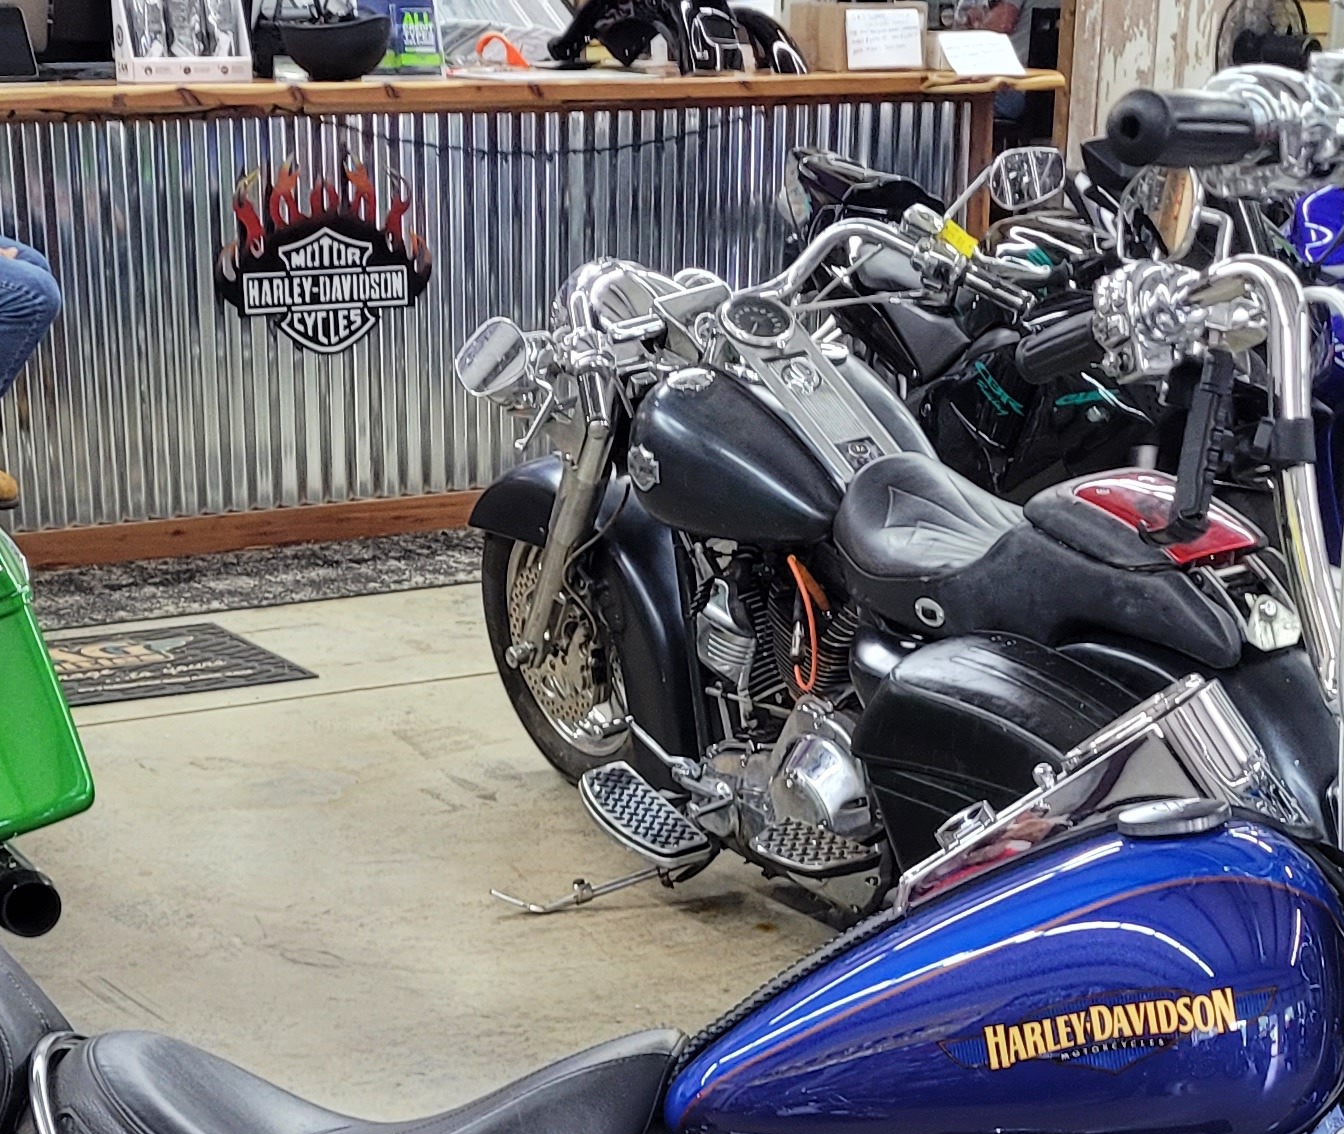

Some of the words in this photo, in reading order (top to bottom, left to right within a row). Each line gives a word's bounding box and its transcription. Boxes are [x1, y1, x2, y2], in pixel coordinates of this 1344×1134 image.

[290, 235, 361, 269] MOTOR
[248, 270, 404, 308] HARLEY-DAVIDSON
[292, 308, 362, 346] CYCLES
[983, 986, 1238, 1071] HARLEY-DAVIDSON
